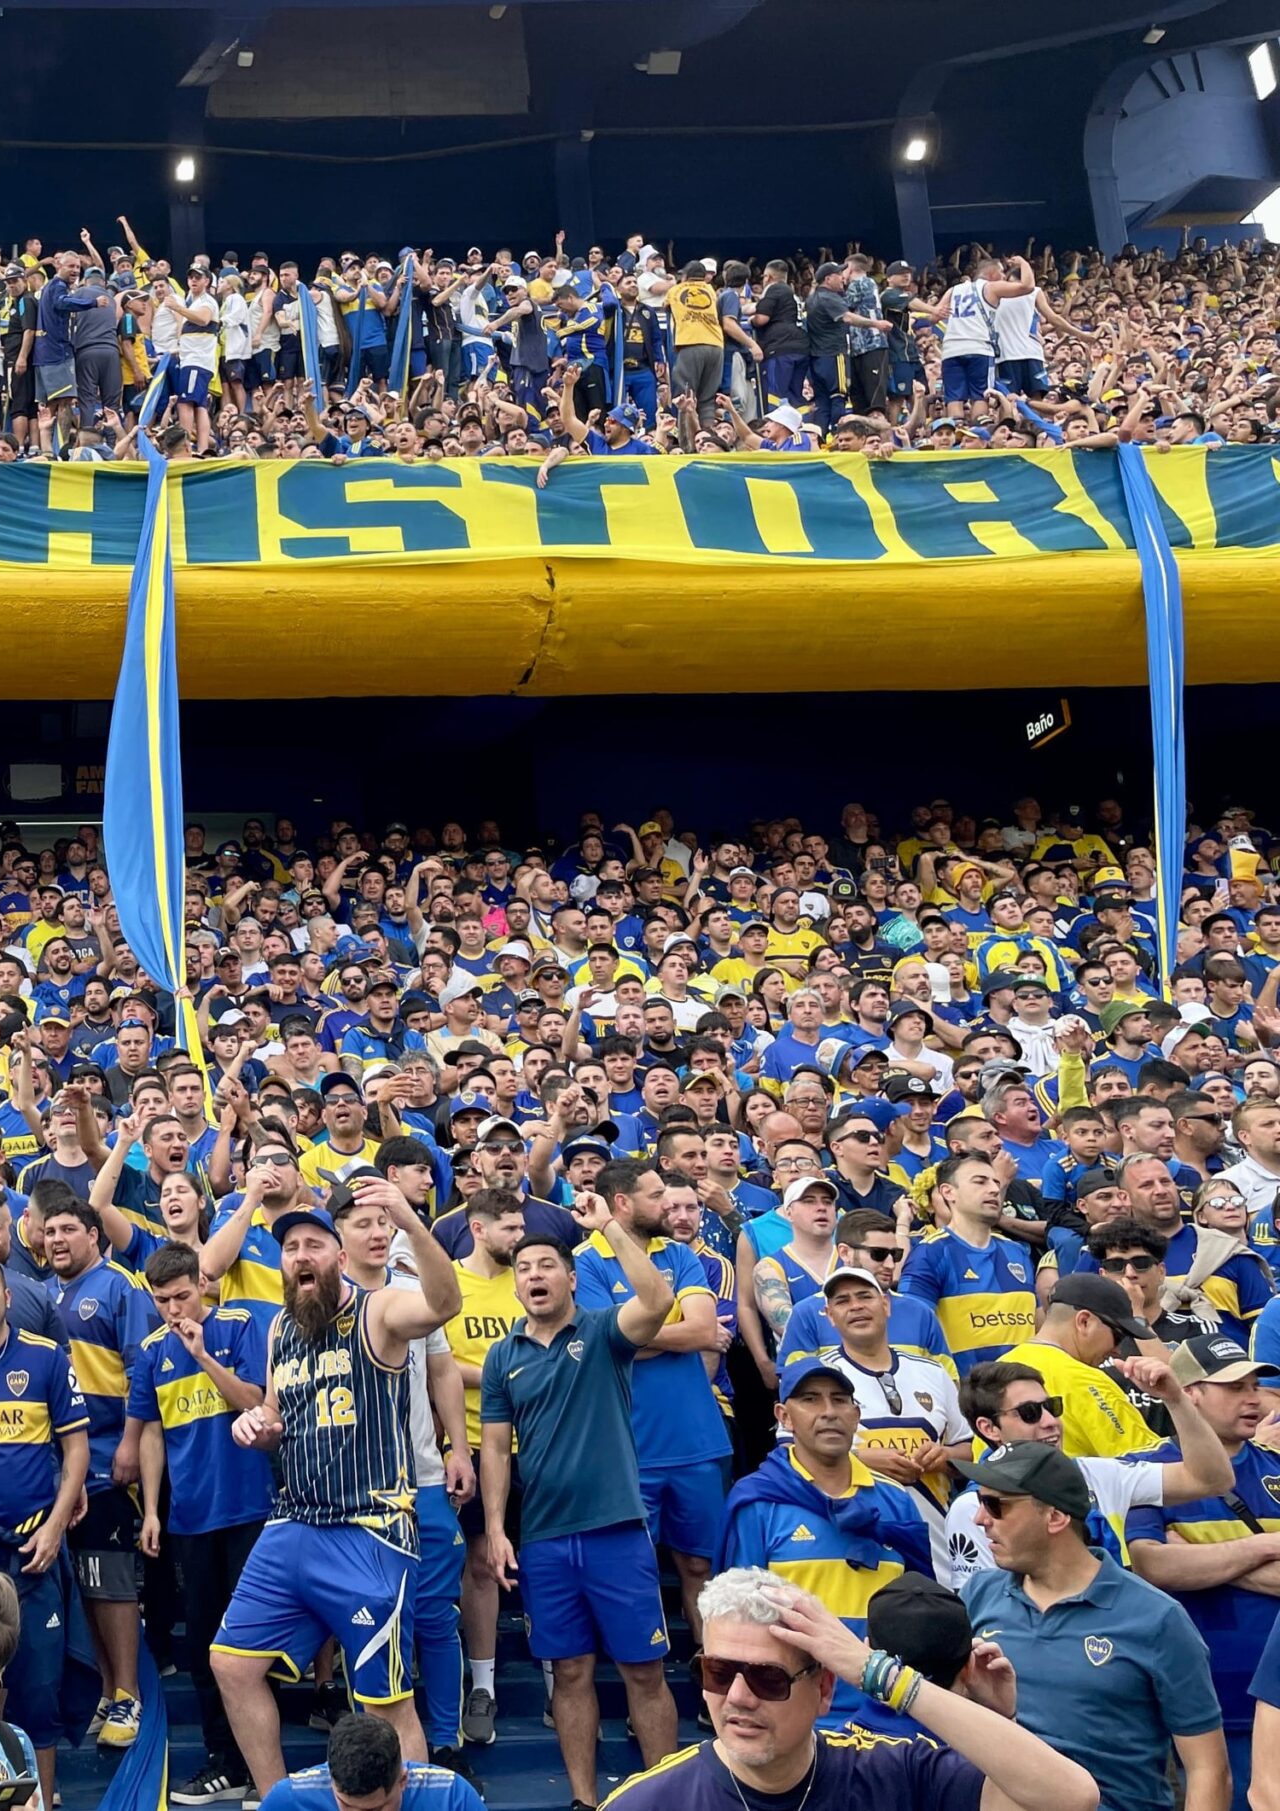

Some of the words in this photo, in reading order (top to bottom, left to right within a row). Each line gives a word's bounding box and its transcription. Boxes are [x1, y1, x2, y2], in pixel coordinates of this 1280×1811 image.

[952, 293, 981, 319] 12
[1026, 713, 1054, 741] Baño
[2, 1140, 36, 1152] QATA
[464, 1316, 517, 1340] BBV
[970, 1310, 1035, 1329] betsso
[315, 1348, 353, 1379] JRS
[176, 1388, 223, 1414] QATA
[315, 1386, 357, 1428] 12
[1088, 1386, 1125, 1436] GOODYEAR
